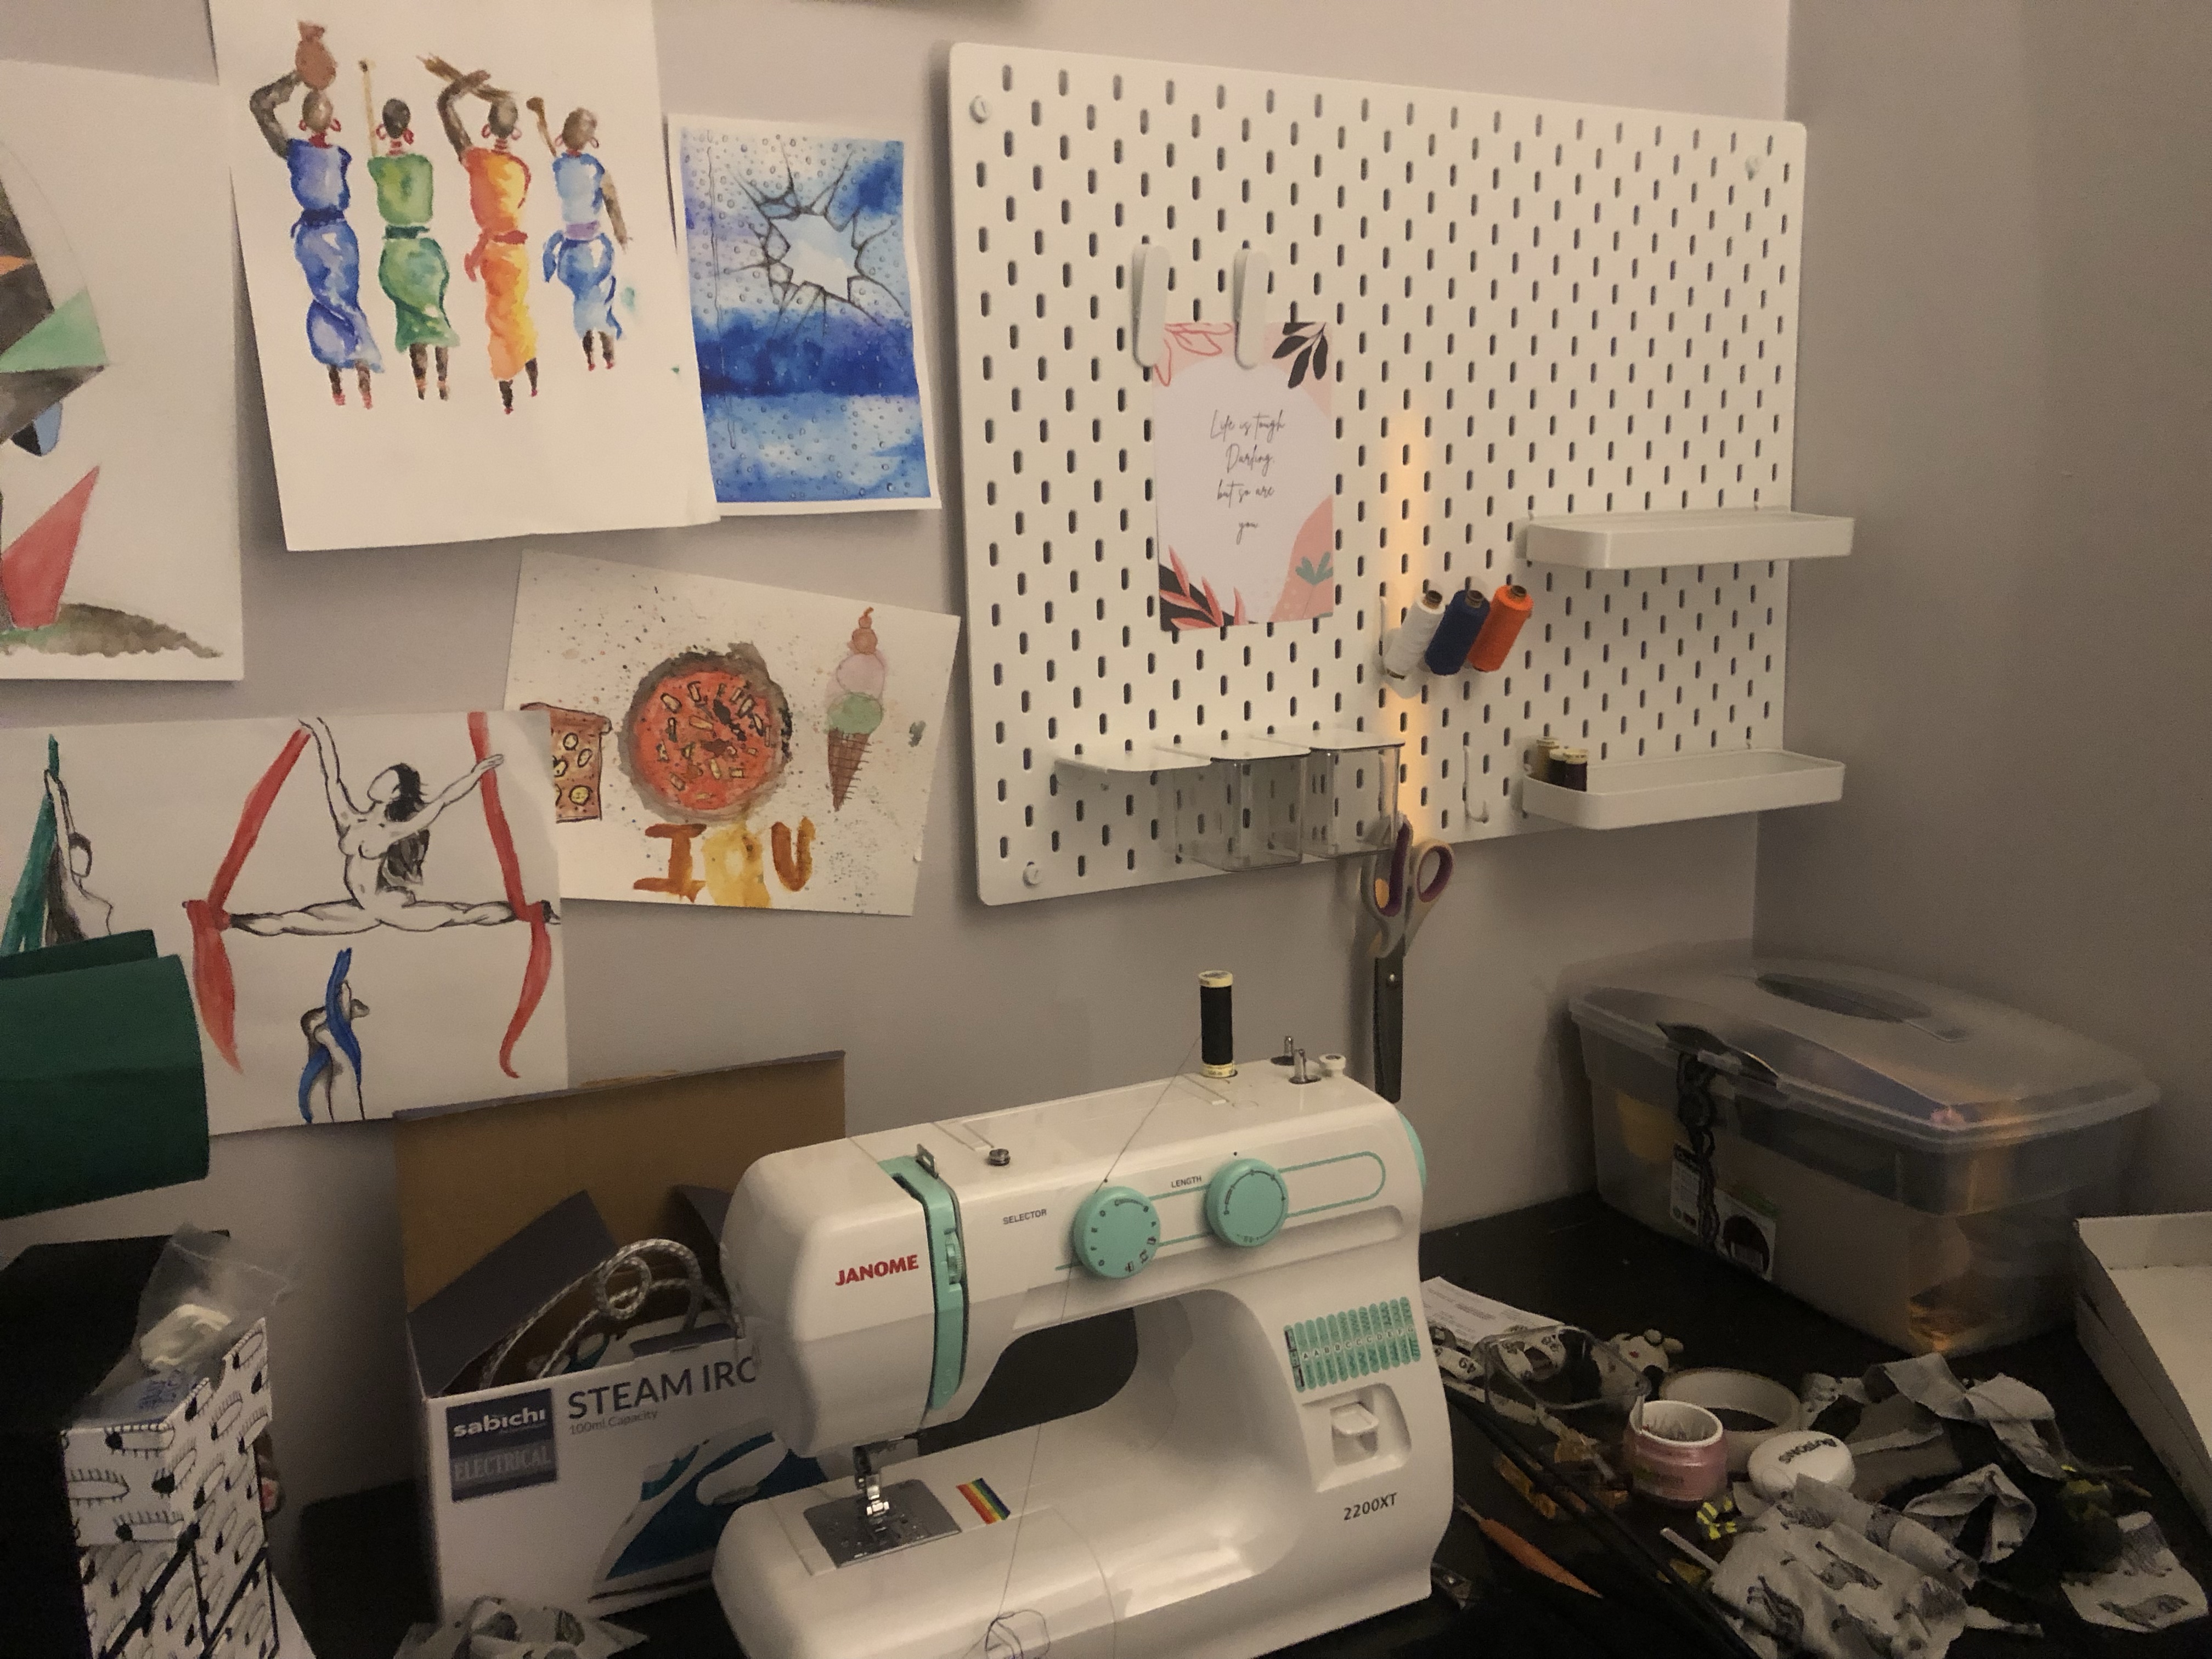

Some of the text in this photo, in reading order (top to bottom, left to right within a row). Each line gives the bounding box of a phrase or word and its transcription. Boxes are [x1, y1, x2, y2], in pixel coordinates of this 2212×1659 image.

[1210, 409, 1285, 443] Life is tough
[1217, 478, 1275, 508] but so are
[1236, 521, 1259, 545] you
[1171, 1175, 1202, 1188] LENGTH
[1002, 1208, 1047, 1224] SELECTOR
[834, 1254, 919, 1286] JANOME
[568, 1368, 692, 1420] STEAM
[453, 1407, 546, 1438] sabichi
[569, 1410, 658, 1435] 100ml Capacity
[454, 1443, 551, 1482] ELECTRICAL
[1344, 1492, 1398, 1521] 2200XT
